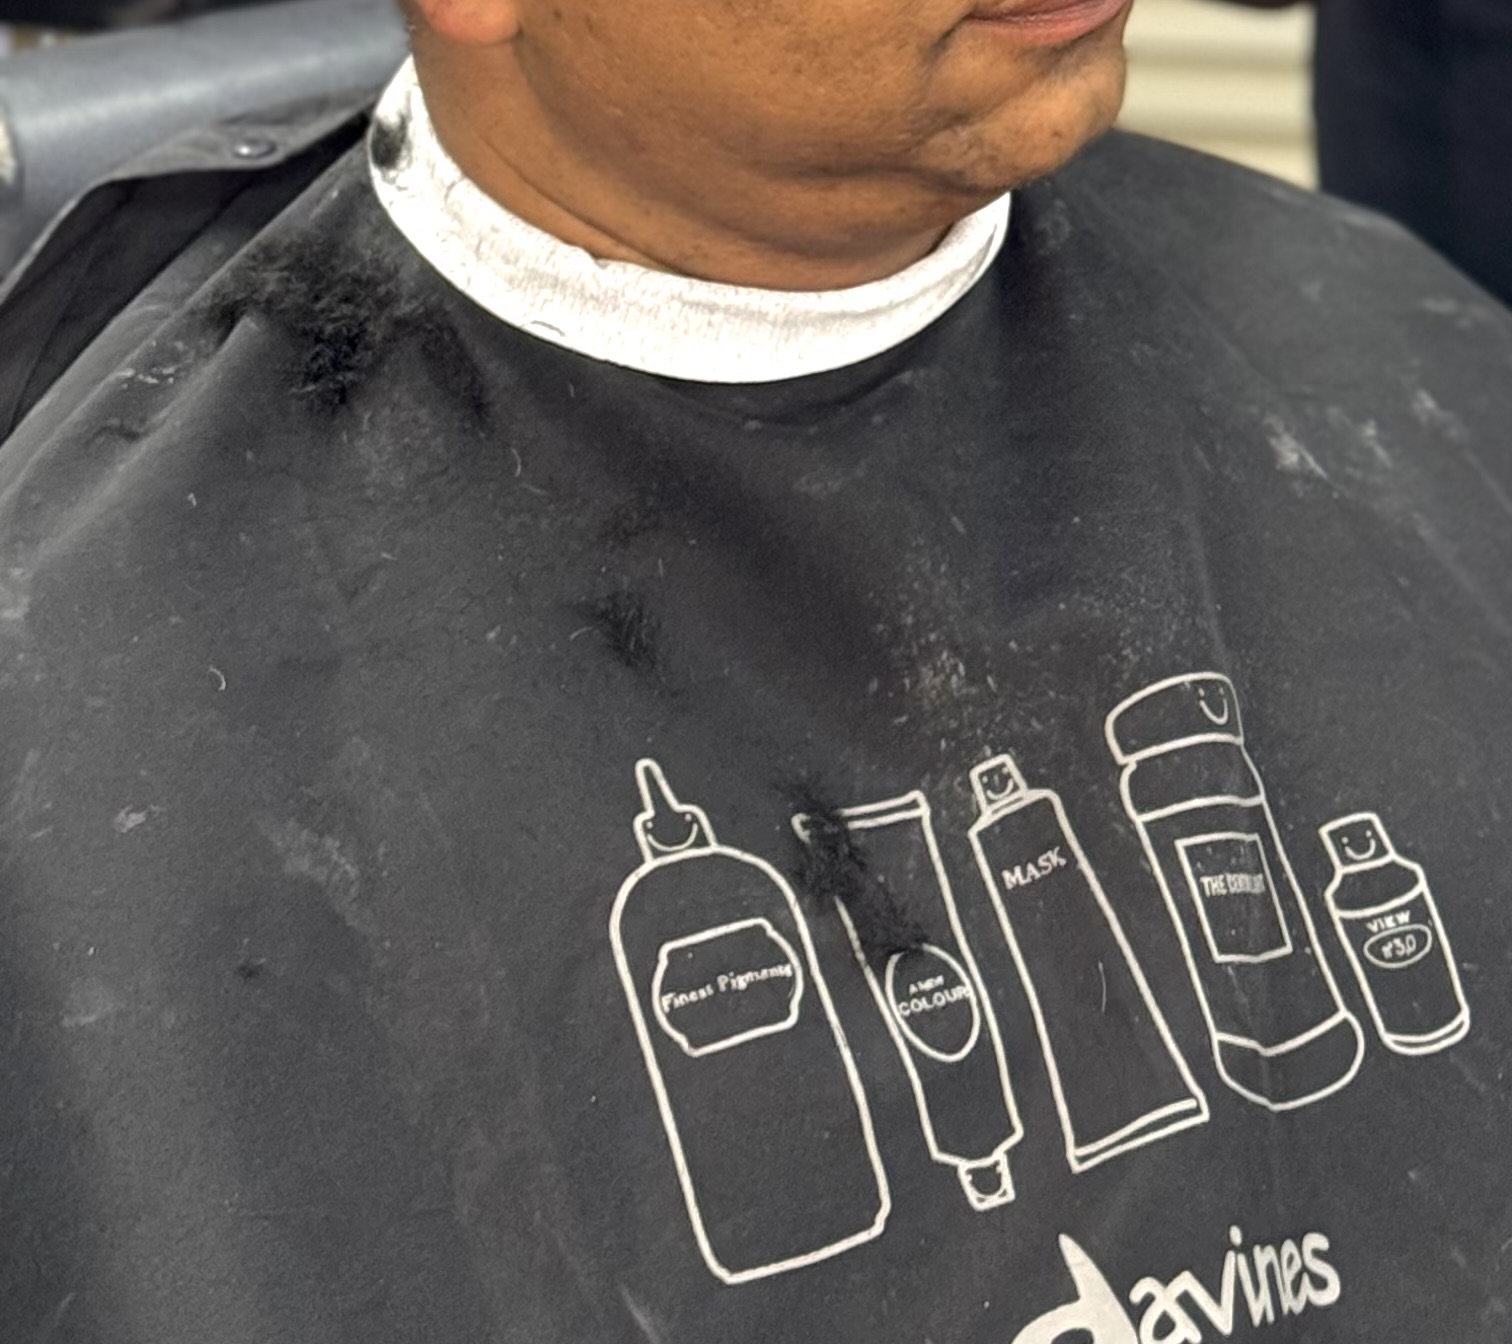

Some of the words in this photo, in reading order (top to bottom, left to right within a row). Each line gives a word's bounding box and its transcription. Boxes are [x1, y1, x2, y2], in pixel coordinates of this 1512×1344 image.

[1001, 846, 1067, 890] MASK
[1200, 874, 1228, 898] THE
[1365, 910, 1411, 933] VIEW
[661, 983, 715, 1013] Finest
[716, 963, 793, 993] Pigments
[899, 985, 971, 1017] COLOUR
[1010, 1224, 1342, 1344] davines
